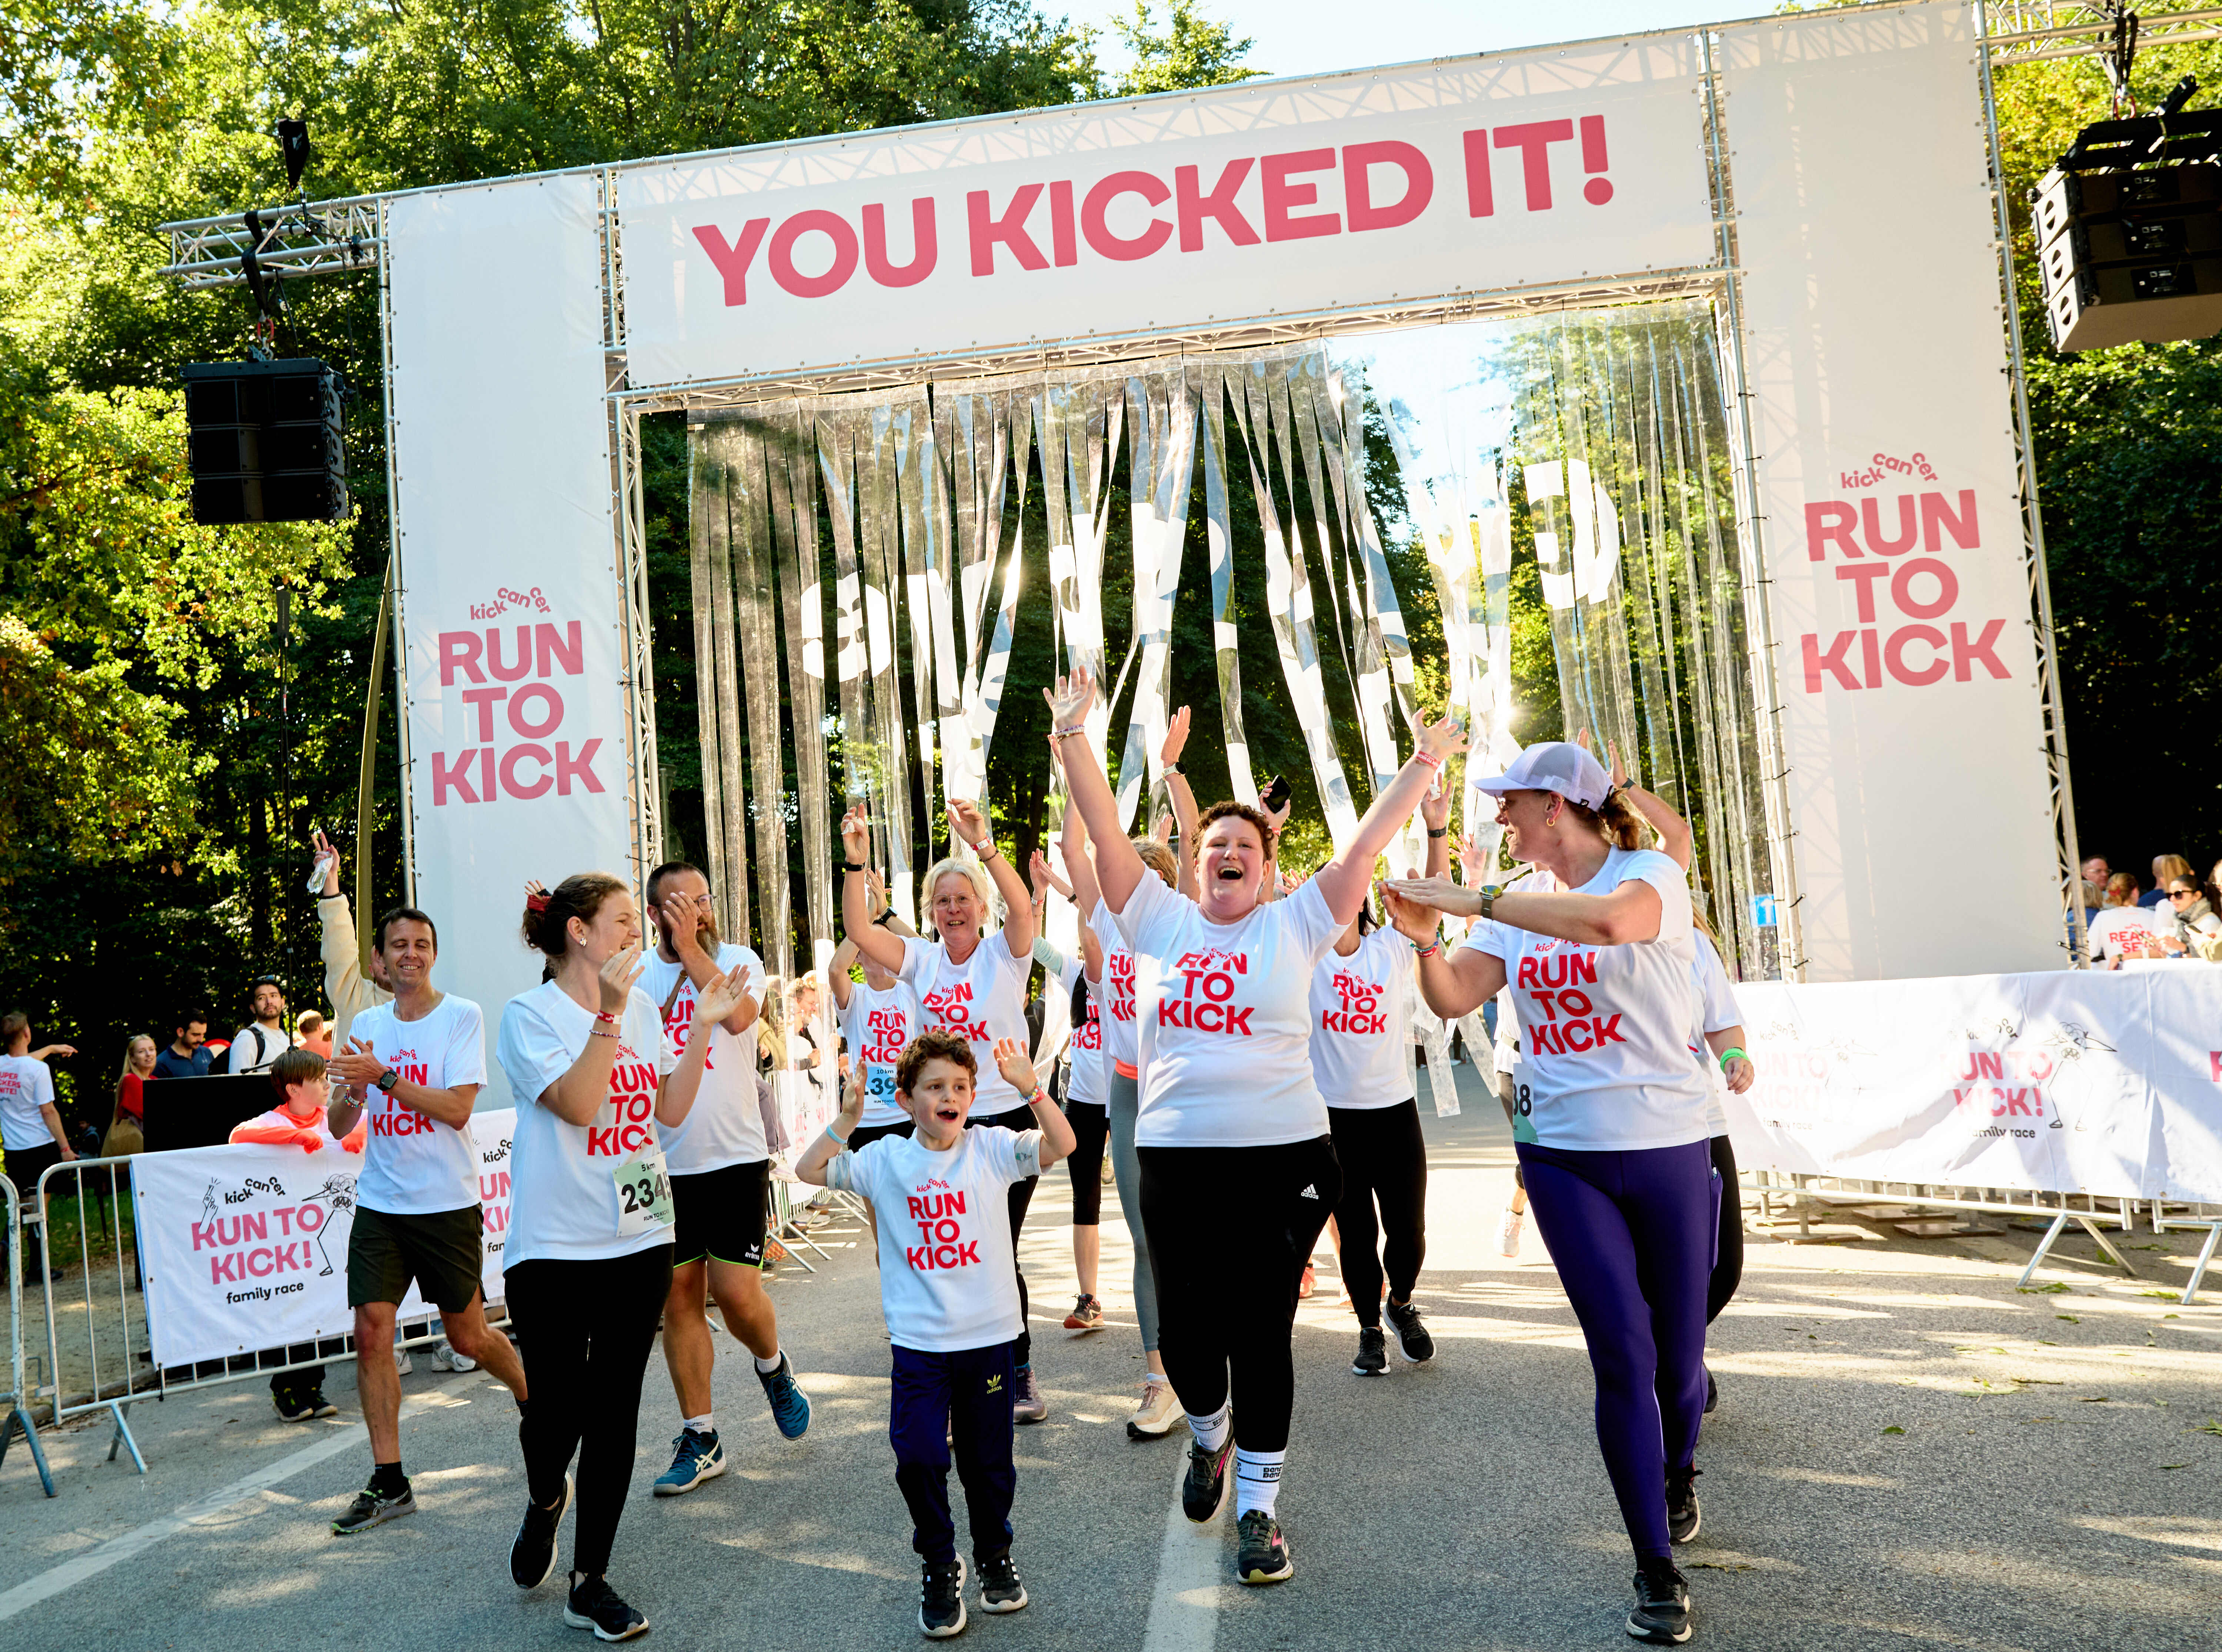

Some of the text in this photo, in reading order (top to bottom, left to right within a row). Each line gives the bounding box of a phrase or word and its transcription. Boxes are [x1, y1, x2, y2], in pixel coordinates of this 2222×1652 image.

[692, 115, 1614, 307] YOU KICKED IT!
[1841, 467, 1886, 489] kick
[1804, 489, 1980, 562] RUN
[1835, 558, 1959, 623] TO
[470, 600, 508, 620] kick
[438, 620, 584, 686] RUN
[1801, 619, 2012, 693] KICK
[462, 682, 564, 742] TO
[432, 738, 605, 806] KICK
[1518, 952, 1598, 989] RUN
[1180, 970, 1234, 1002] TO
[928, 1004, 969, 1024] TO
[1158, 997, 1255, 1036] KICK
[1338, 991, 1377, 1013] TO
[1530, 989, 1593, 1021] TO
[867, 1010, 906, 1030] RUN
[1322, 1010, 1387, 1034] KICK
[1528, 1013, 1627, 1056] KICK
[873, 1029, 905, 1047] TO
[2007, 1051, 2052, 1080] TO
[610, 1093, 651, 1124] TO
[1953, 1087, 2043, 1117] KICK!
[373, 1113, 435, 1136] KICK
[2010, 1129, 2035, 1138] race
[483, 1148, 508, 1163] kick
[225, 1187, 254, 1205] kick
[917, 1184, 931, 1193] kick
[907, 1191, 966, 1219] RUN
[191, 1203, 324, 1251] RUN TO
[918, 1219, 960, 1244] TO
[210, 1240, 313, 1285] KICK!
[745, 1252, 760, 1260] erima
[907, 1240, 981, 1270] KICK
[226, 1281, 304, 1304] family race
[987, 1385, 1002, 1394] adidas
